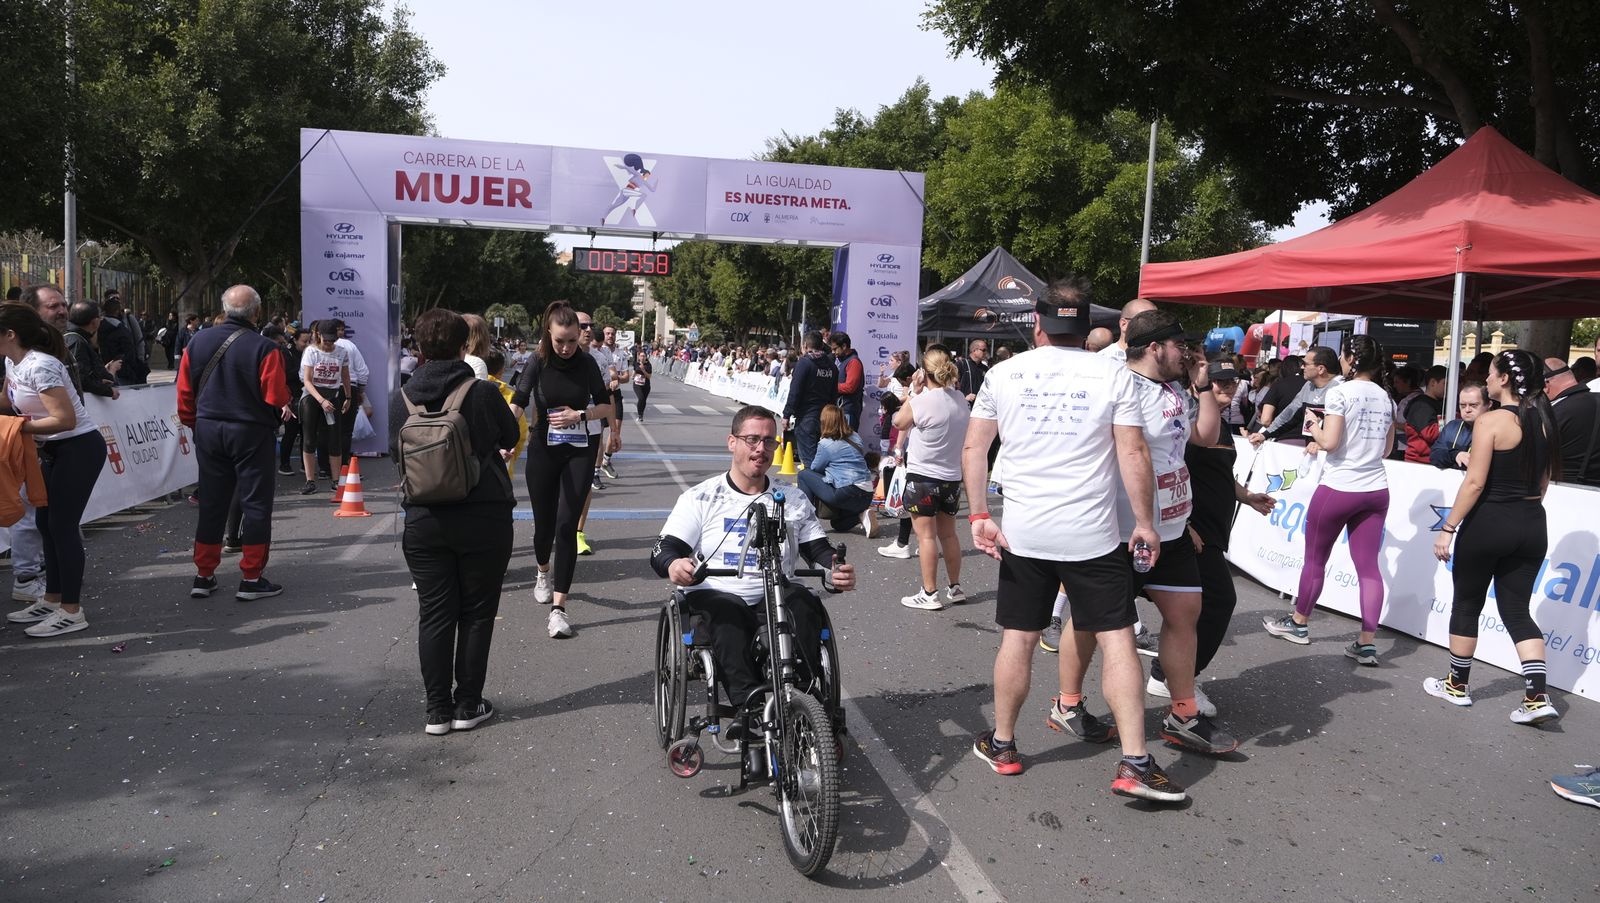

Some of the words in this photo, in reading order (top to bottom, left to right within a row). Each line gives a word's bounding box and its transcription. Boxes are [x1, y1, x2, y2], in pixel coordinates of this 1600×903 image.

[403, 151, 477, 169] CARRERA
[481, 156, 502, 170] DE
[506, 158, 526, 172] LA
[746, 173, 762, 186] LA
[766, 175, 832, 191] IGUALDAD
[395, 170, 533, 209] MUJER
[725, 191, 742, 204] ES
[744, 193, 808, 208] NUESTRA
[810, 197, 851, 210] META.
[730, 211, 752, 223] CDX
[326, 233, 364, 241] HYUNDAI
[335, 251, 366, 260] cajamar
[876, 279, 902, 287] cajamar
[337, 288, 365, 297] vithas
[332, 310, 365, 319] aqualia
[876, 312, 900, 321] vithas
[871, 332, 899, 341] aqualia
[125, 415, 175, 447] ALMERÍA
[1169, 482, 1188, 501] 700
[1430, 597, 1447, 614] tu
